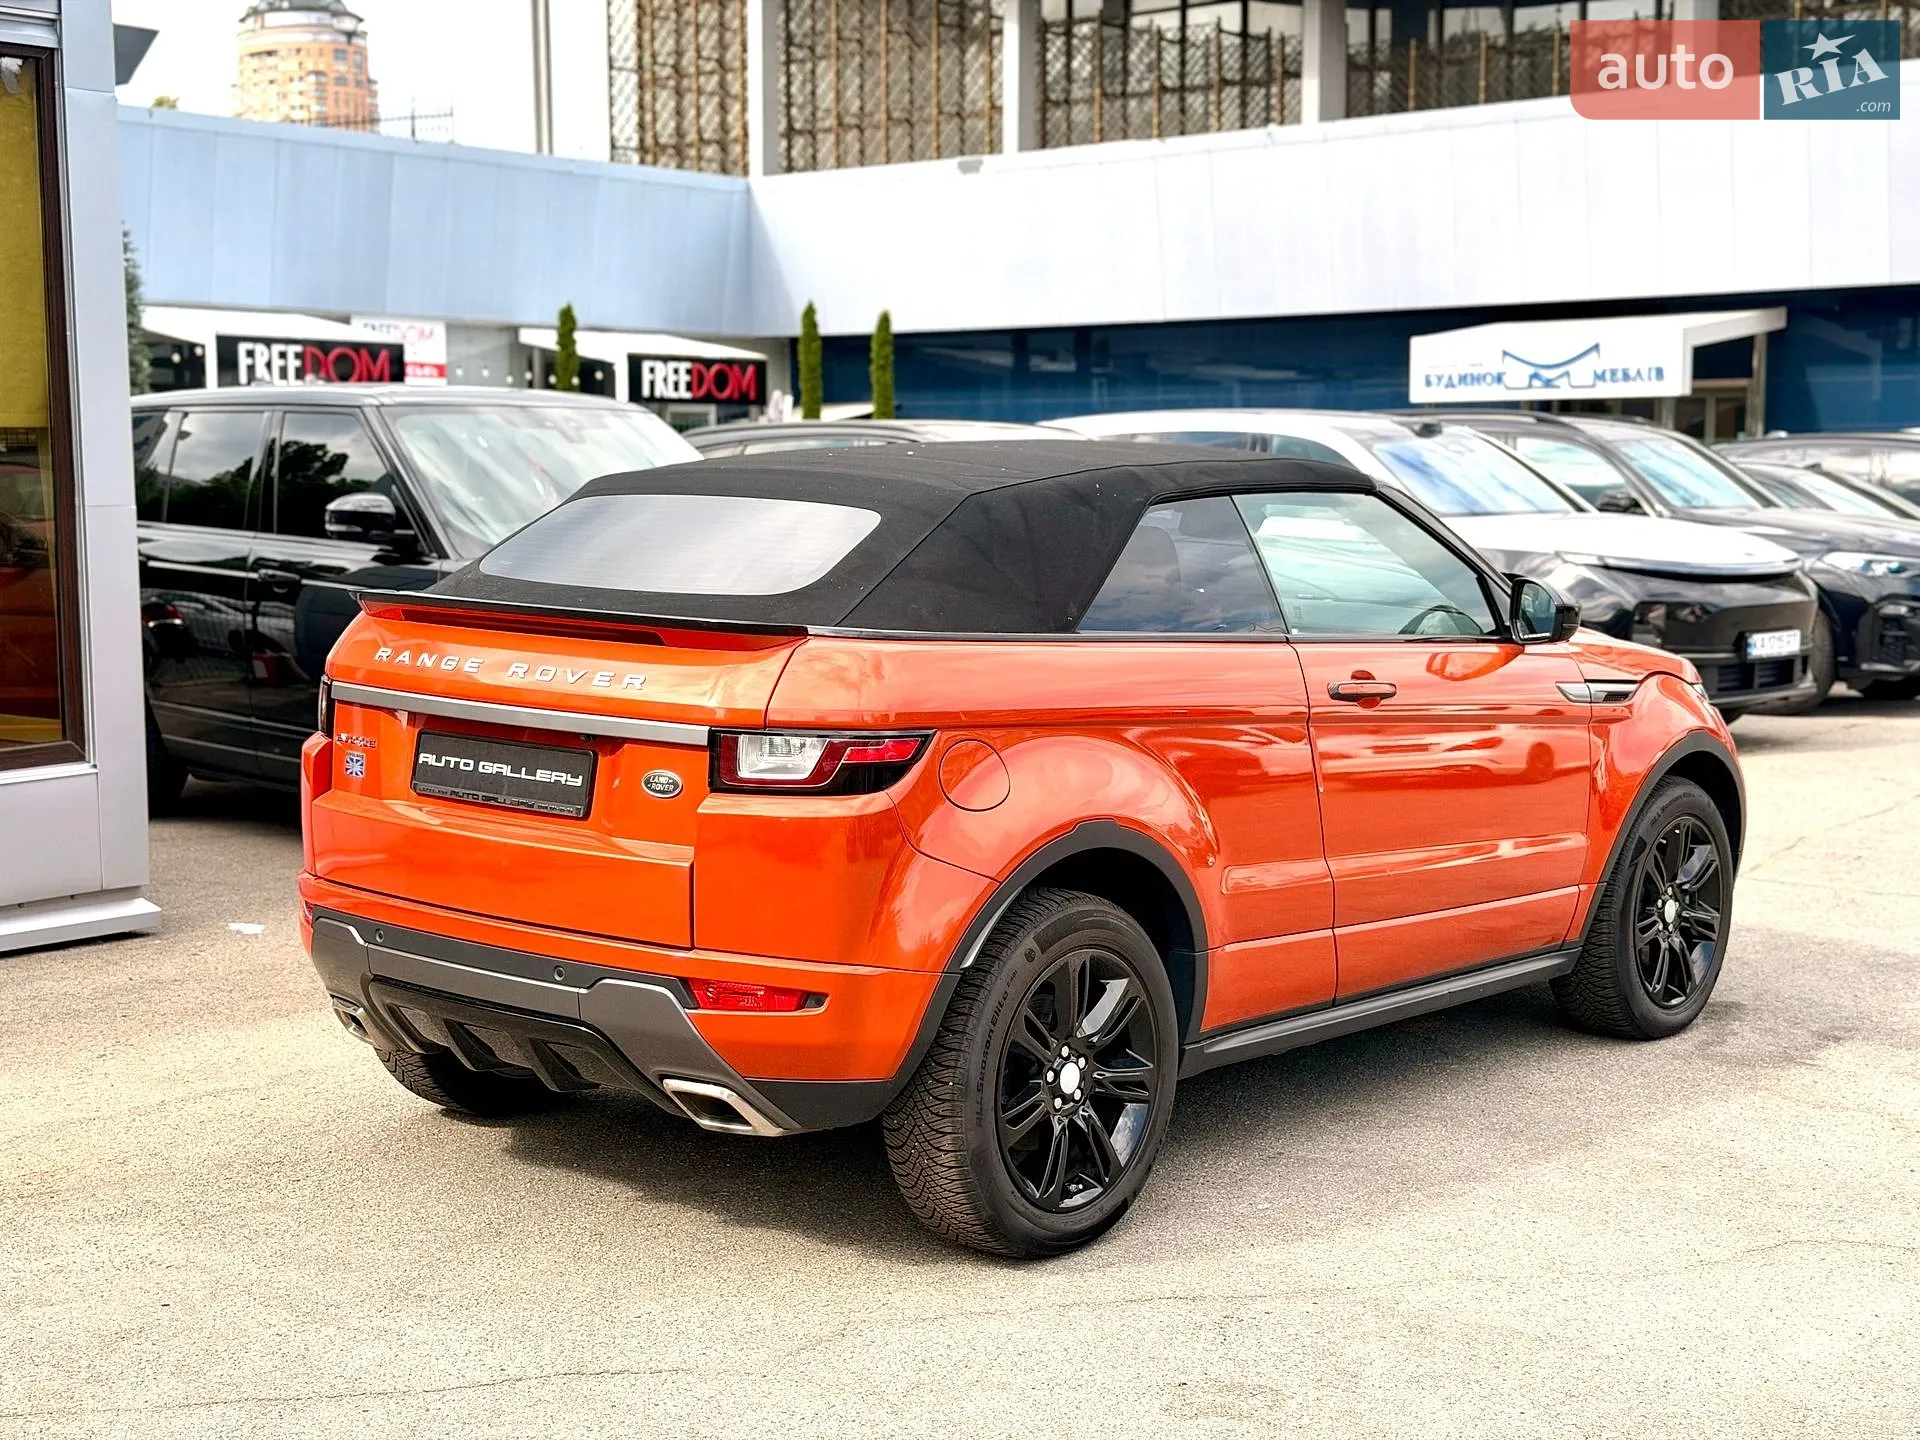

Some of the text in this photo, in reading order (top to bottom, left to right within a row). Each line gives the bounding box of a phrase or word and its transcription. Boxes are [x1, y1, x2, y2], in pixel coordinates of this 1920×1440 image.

[237, 341, 391, 386] FREEDOM
[1424, 365, 1665, 389] БУДИНОК МЕБЛІВ
[641, 360, 757, 400] FREEDOM
[374, 646, 648, 691] RANGE ROVER
[418, 752, 583, 787] AUTO GALLERY
[650, 775, 669, 784] LAND
[450, 790, 480, 801] AUTO
[651, 783, 675, 792] ROVER
